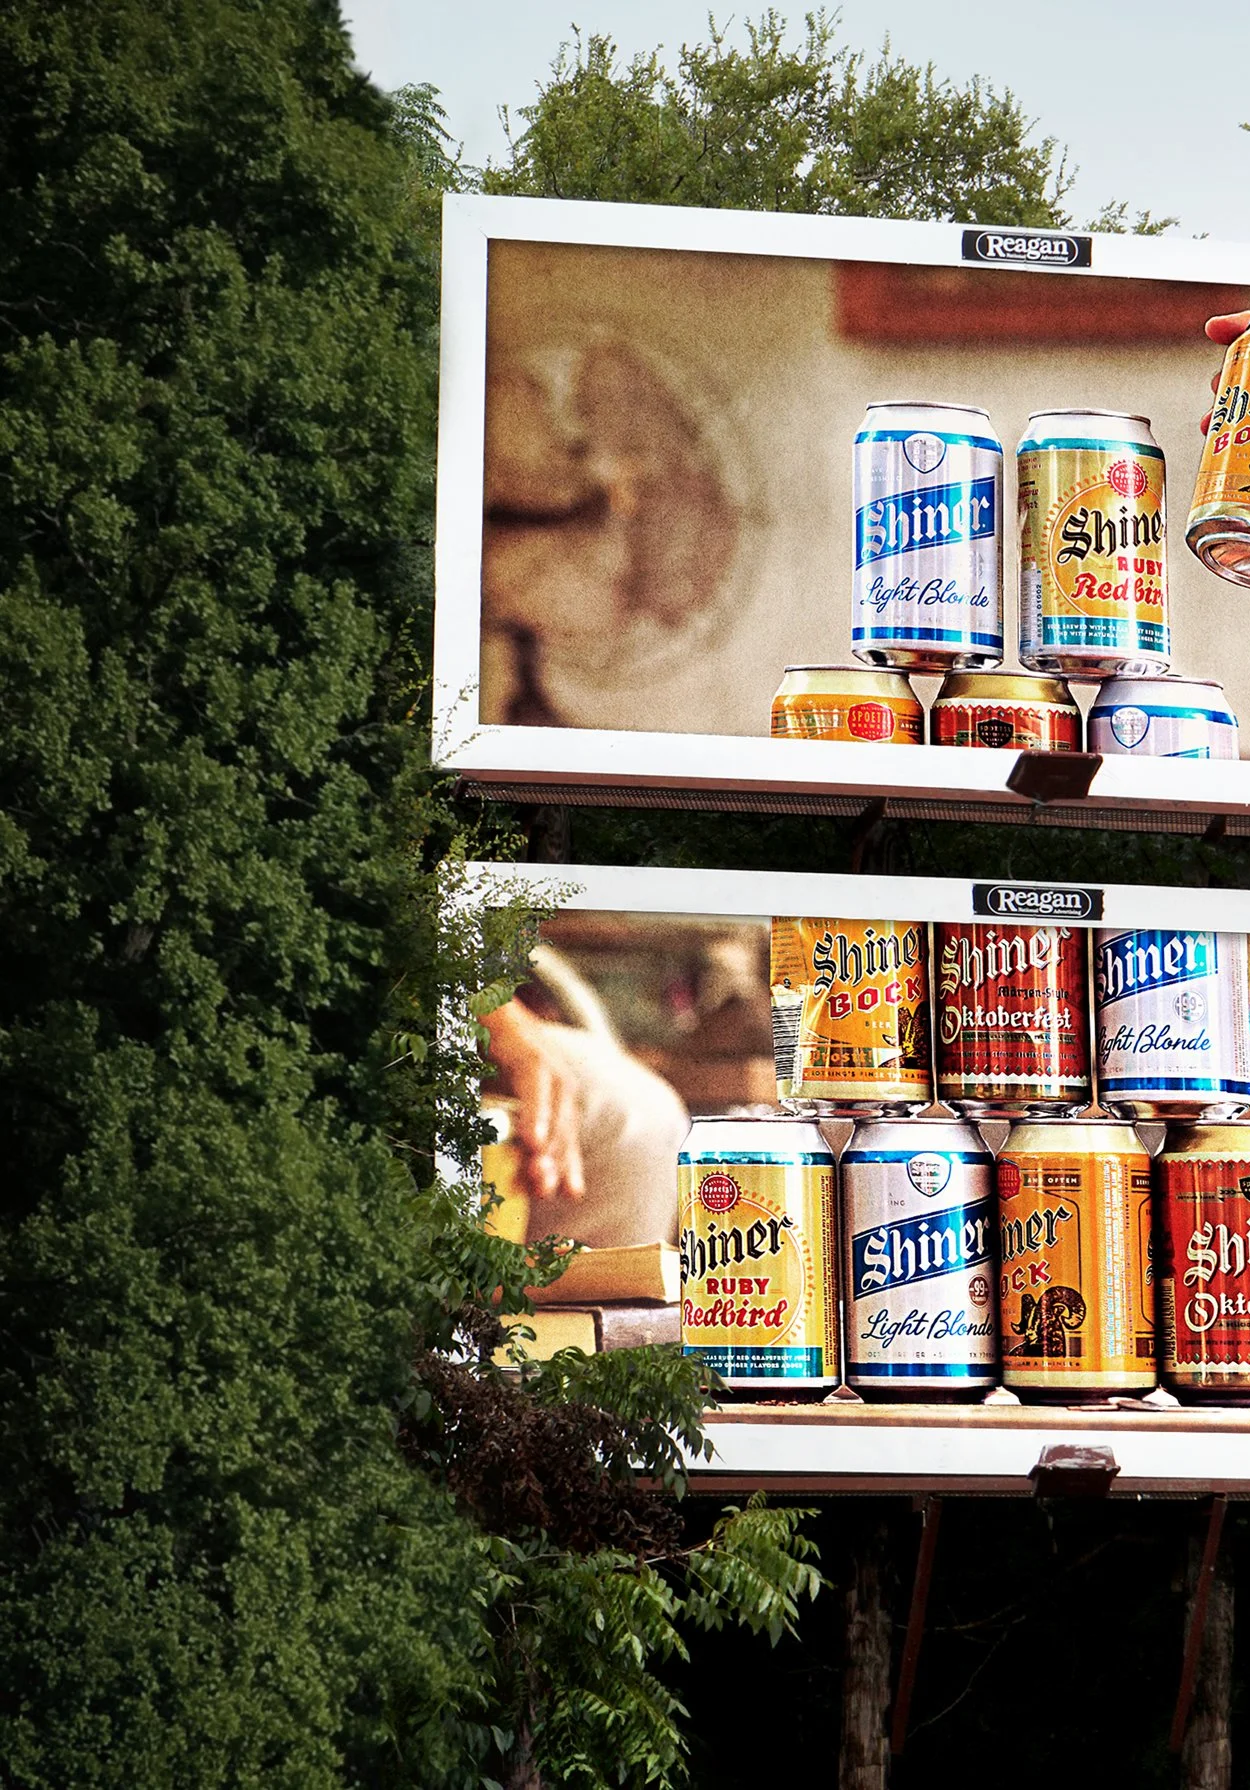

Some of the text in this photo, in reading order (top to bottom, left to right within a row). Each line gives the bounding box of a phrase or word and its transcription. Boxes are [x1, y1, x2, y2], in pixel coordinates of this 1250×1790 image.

[986, 235, 1069, 260] Reagan
[861, 496, 990, 560] Shiner
[1057, 505, 1165, 565] Shine
[1117, 556, 1162, 577] RUBY
[860, 576, 920, 613] Light
[997, 889, 1082, 914] Reagan
[940, 926, 1071, 999] Shiner
[826, 976, 922, 1020] BOCK
[940, 1004, 1072, 1045] Oktoberfest
[1132, 1024, 1211, 1053] Blonde
[680, 1215, 794, 1285] Shiner
[861, 1216, 990, 1290] Shiner
[1001, 1206, 1072, 1263] iner
[706, 1278, 770, 1295] RUBY
[973, 1280, 985, 1296] 99
[1001, 1260, 1052, 1299] OCK
[683, 1298, 788, 1328] Redbird
[860, 1309, 993, 1349] Light Blonde
